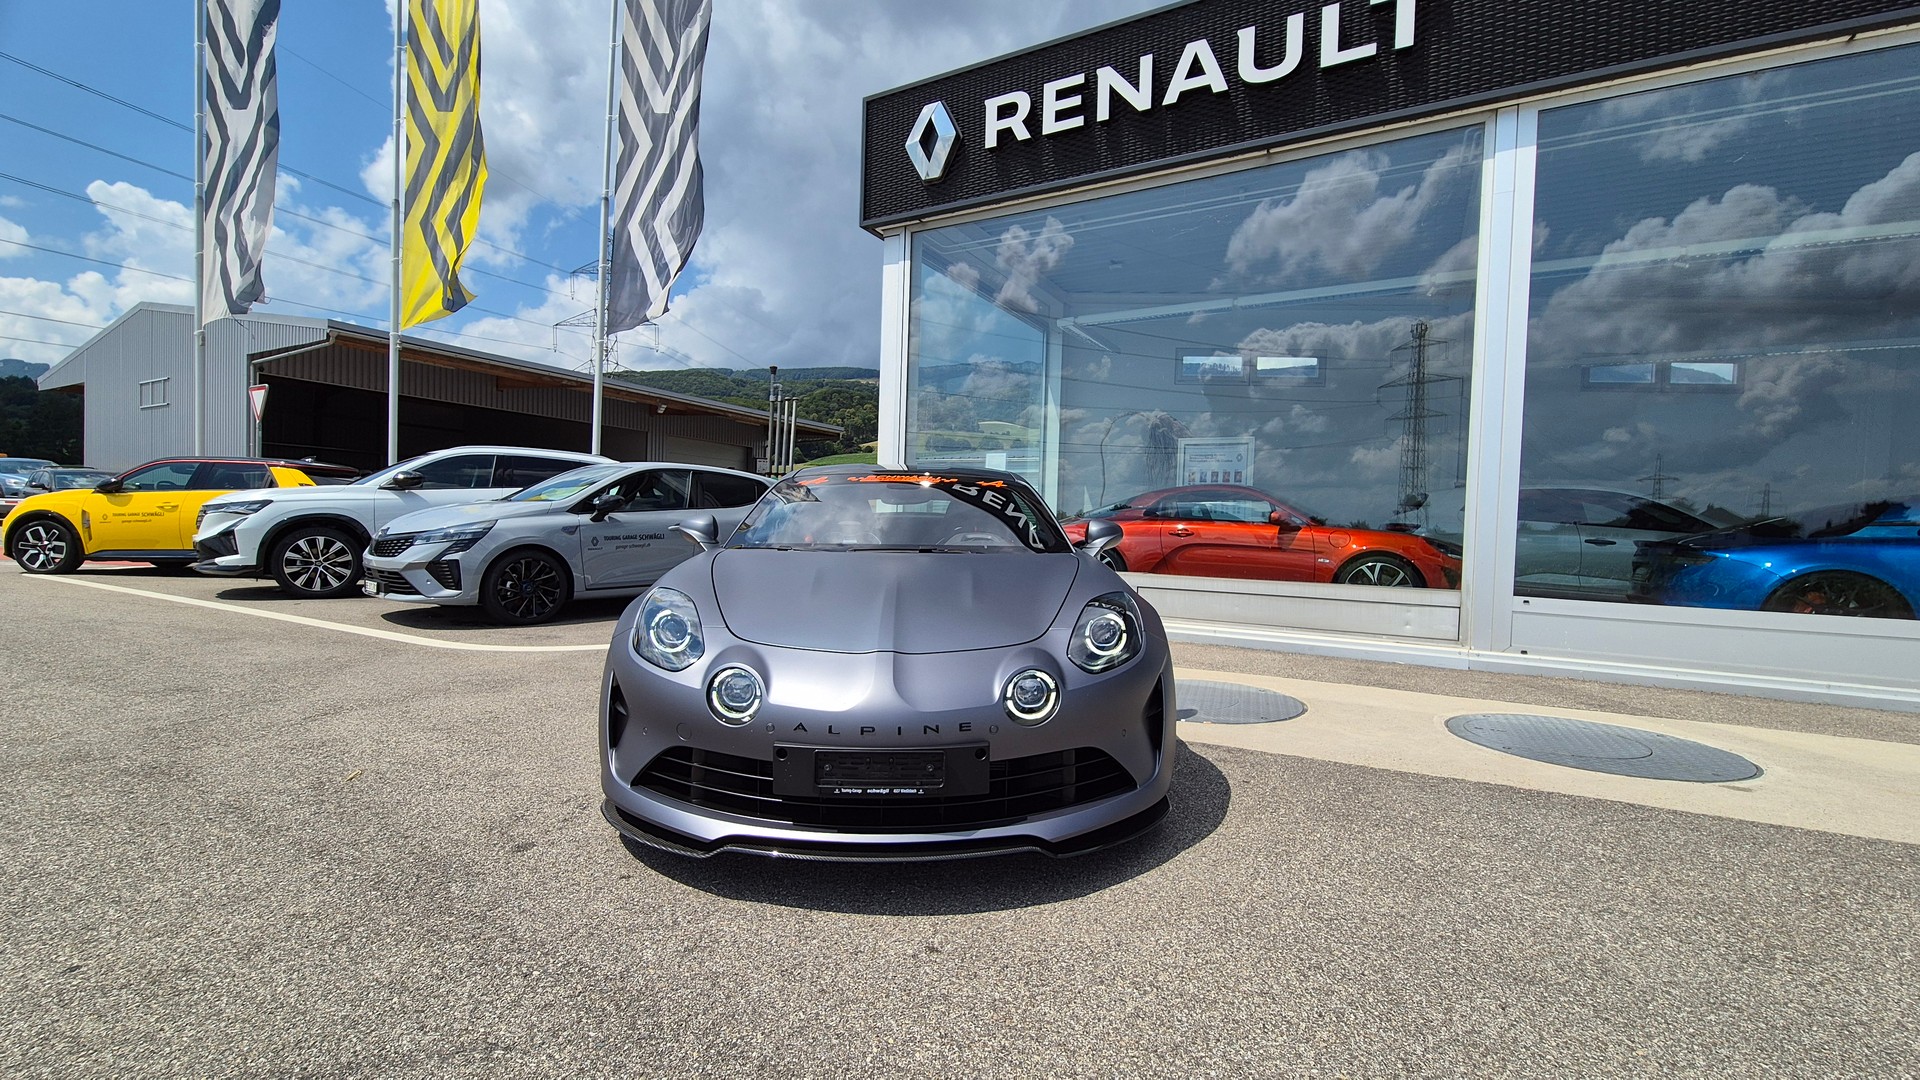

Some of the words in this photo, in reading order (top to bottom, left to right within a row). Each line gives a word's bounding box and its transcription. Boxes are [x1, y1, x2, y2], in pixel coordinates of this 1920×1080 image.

[984, 0, 1417, 149] RENAULT
[638, 532, 665, 541] SCHWÄGLI
[792, 721, 972, 736] ALPINE
